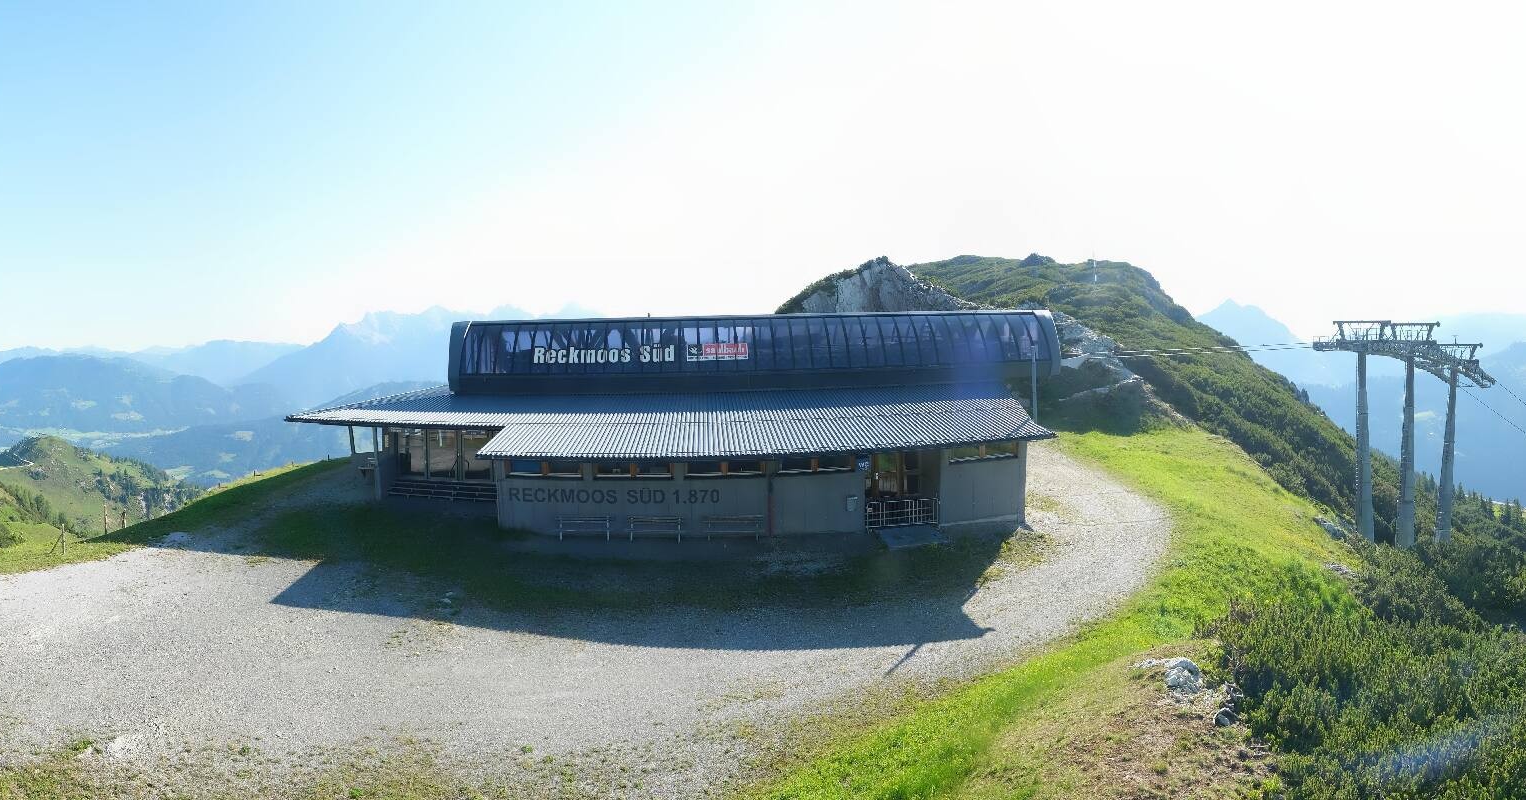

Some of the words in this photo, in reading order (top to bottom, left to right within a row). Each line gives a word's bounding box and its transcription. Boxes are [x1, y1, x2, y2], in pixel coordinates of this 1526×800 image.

[533, 346, 631, 364] Reckmoos
[639, 343, 675, 363] Süd
[508, 487, 618, 505] RECKMOOS
[626, 486, 666, 505] SÜD
[672, 489, 721, 505] 1.870
